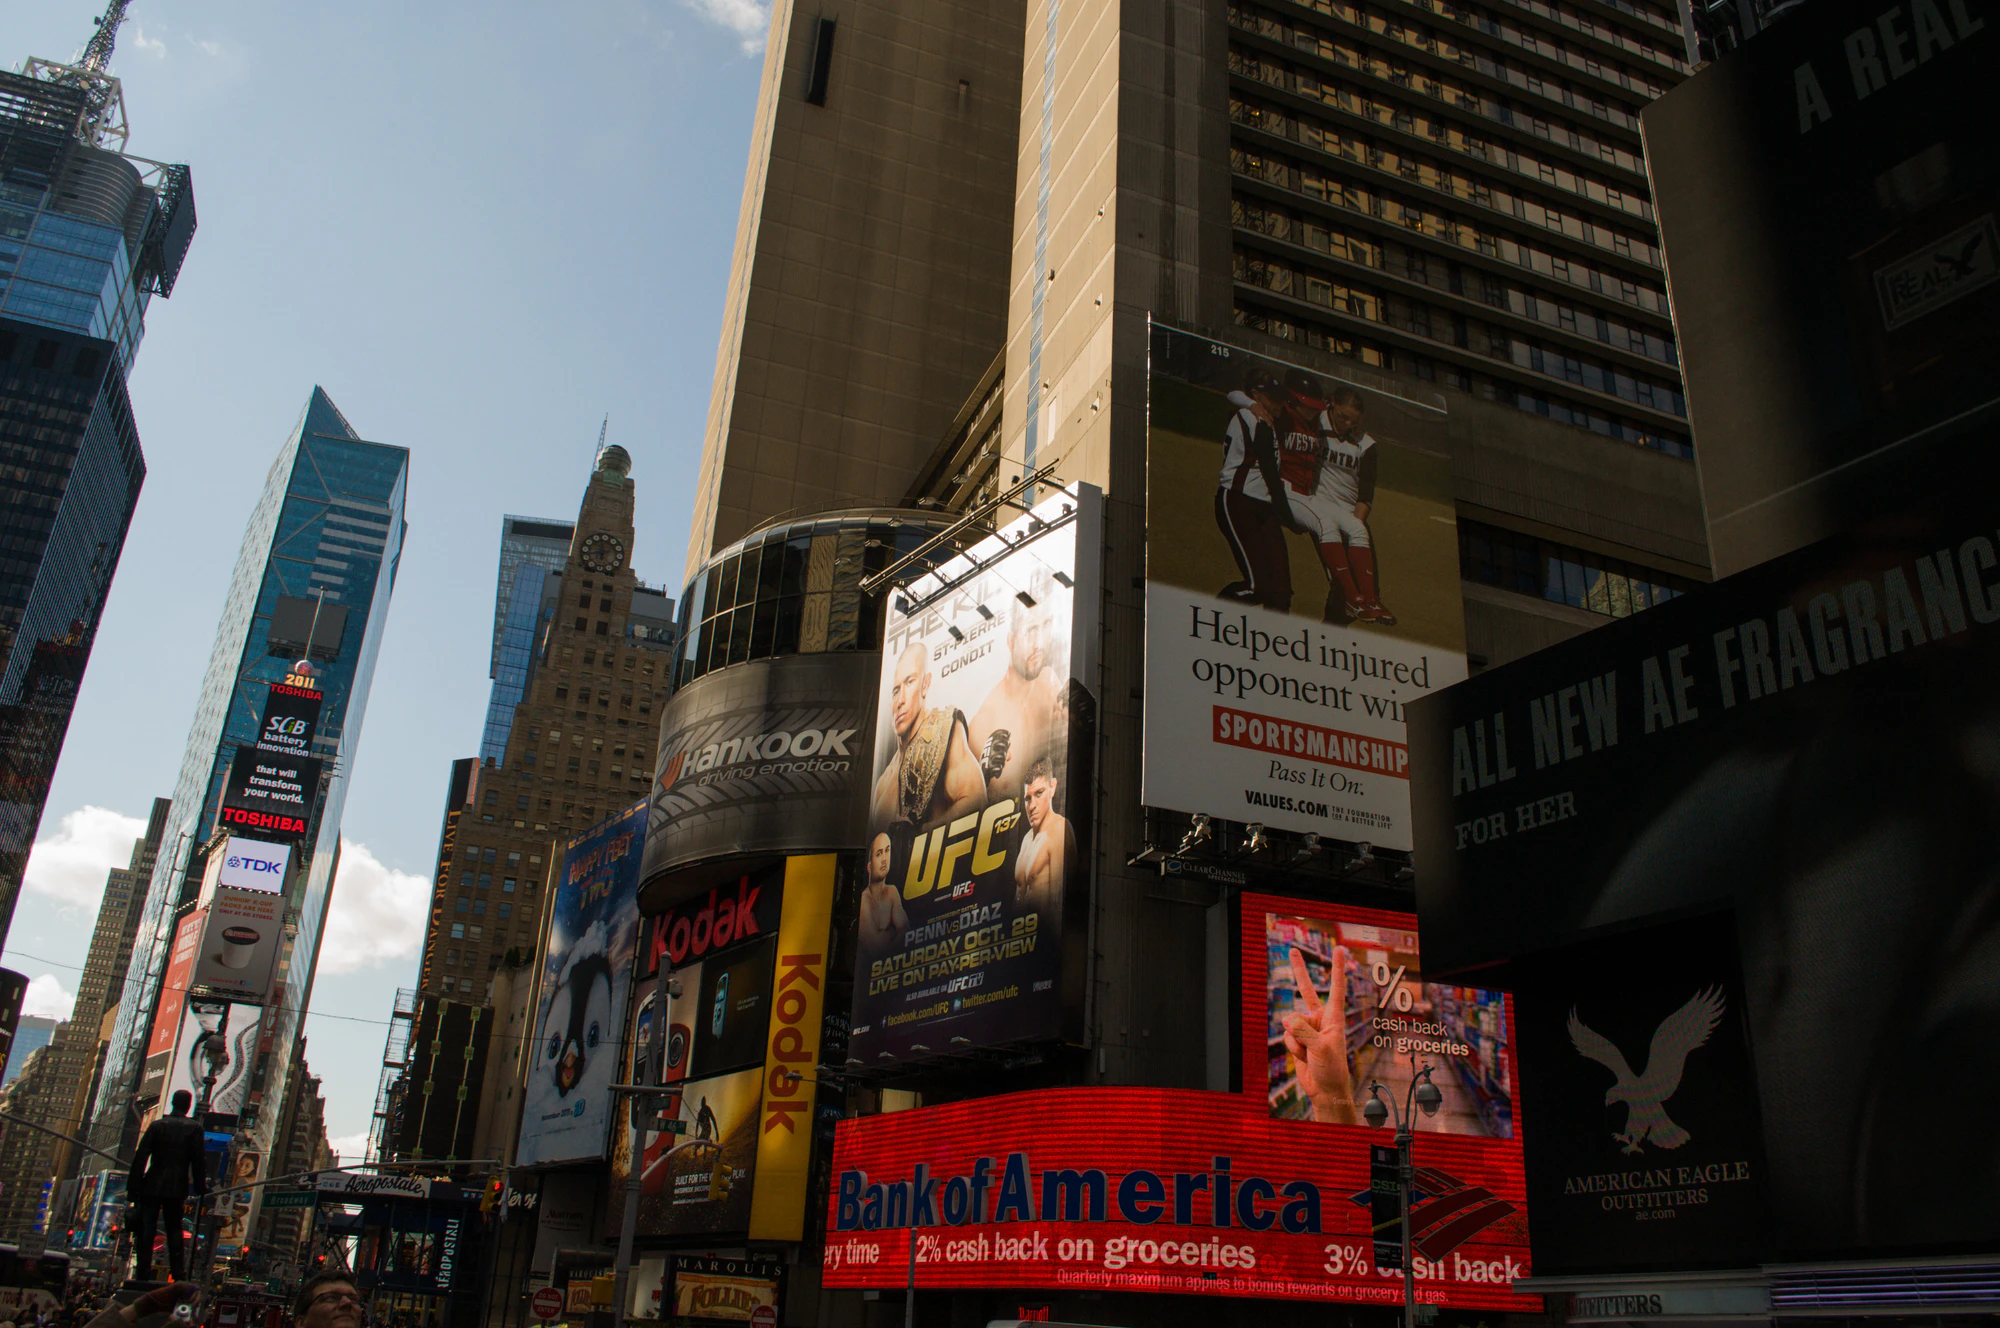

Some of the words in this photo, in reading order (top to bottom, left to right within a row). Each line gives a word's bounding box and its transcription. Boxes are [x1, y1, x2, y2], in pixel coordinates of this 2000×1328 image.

[1793, 60, 1833, 136] A
[1842, 0, 1985, 101] REAL
[1210, 344, 1230, 358] 215
[941, 639, 995, 679] CONDIT
[1189, 605, 1311, 662] Helped
[1320, 634, 1431, 689] injured
[1451, 711, 1516, 797] ALL
[1530, 669, 1620, 770] NEW
[1641, 643, 1699, 735] AE
[1711, 528, 2000, 711] FRAGRANC
[270, 683, 323, 701] TOSHIBA
[284, 673, 315, 689] 2011
[1192, 657, 1352, 712] opponent
[256, 741, 310, 758] innovation
[264, 731, 307, 749] battery
[1219, 711, 1409, 774] SPORTSMANSHIP
[250, 775, 303, 792] transform
[256, 765, 277, 776] that
[278, 767, 297, 779] will
[698, 765, 756, 787] driving
[759, 758, 850, 776] emotion
[1268, 760, 1306, 785] Pass
[1311, 768, 1326, 788] It
[244, 787, 270, 799] your
[271, 791, 305, 804] world.
[1245, 790, 1329, 818] VALUES.COM
[223, 807, 305, 833] TOSHIBA
[1332, 806, 1344, 815] THE
[1347, 808, 1391, 822] FOUNDATION
[1351, 816, 1375, 827] BETTER
[1455, 809, 1508, 851] FOR
[1515, 790, 1578, 834] HER
[443, 809, 462, 853] LIVE
[902, 798, 1016, 901] UFC
[993, 812, 1022, 835] 137
[241, 857, 282, 874] TDK
[435, 860, 452, 900] FOR
[952, 880, 971, 898] UFC
[648, 875, 762, 973] Kodak
[904, 920, 947, 948] PENN
[959, 901, 1002, 930] DIAZ
[420, 908, 444, 990] DANGER
[870, 936, 962, 977] SATURDAY
[964, 922, 1005, 951] OCT.
[1011, 913, 1039, 936] 29
[868, 975, 899, 996] LIVE
[902, 968, 925, 986] ON
[928, 934, 1039, 980] PAY-PER-VIEW
[947, 975, 969, 994] UFC
[887, 1001, 950, 1028] facebook.com/UFC
[962, 985, 1019, 1009] twitter.com/ufc
[1372, 1017, 1408, 1033] cash
[1412, 1018, 1448, 1037] back
[764, 953, 822, 1135] Kodak
[1373, 1034, 1392, 1049] on
[1397, 1037, 1470, 1057] groceries
[344, 1174, 426, 1199] Aéropostale
[1563, 1168, 1672, 1195] AMERICAN
[1676, 1161, 1750, 1186] EAGLE
[271, 1196, 309, 1206] Broadway
[836, 1163, 942, 1231] Bank
[943, 1156, 997, 1227] of
[994, 1152, 1323, 1235] America
[1601, 1188, 1708, 1211] OUTFITTERS
[1635, 1208, 1676, 1221] ae.com
[846, 1238, 880, 1264] time
[915, 1234, 942, 1263] 2%
[946, 1231, 990, 1263] cash
[994, 1230, 1050, 1261] back
[1057, 1237, 1094, 1262] on
[1103, 1235, 1257, 1269] groceries
[676, 1258, 782, 1276] MARQUIS
[1323, 1244, 1369, 1276] 3%
[1454, 1251, 1522, 1284] back
[1057, 1268, 1113, 1288] Quarterly
[1115, 1271, 1183, 1288] maximum
[1186, 1274, 1231, 1292] applies
[1233, 1275, 1245, 1291] to
[1249, 1277, 1285, 1294] bonus
[1287, 1280, 1335, 1297] rewards
[1338, 1285, 1352, 1298] on
[1355, 1285, 1399, 1302] grocery
[1402, 1286, 1423, 1300] ad
[1425, 1289, 1449, 1304] gas.
